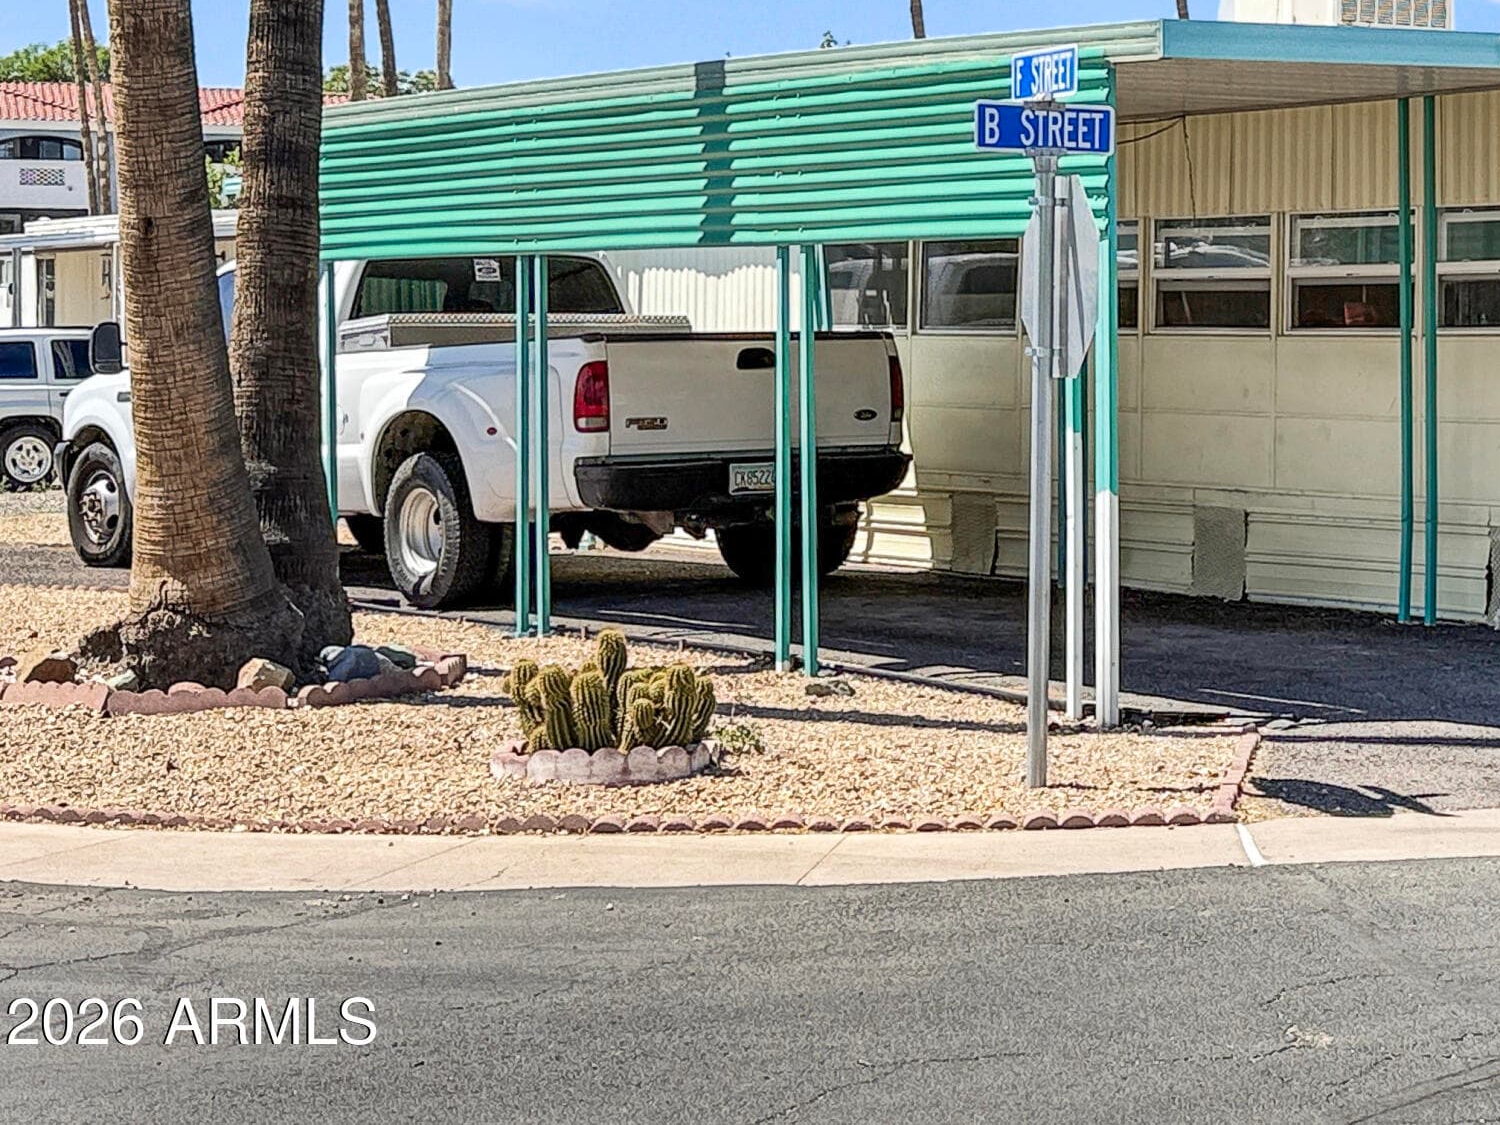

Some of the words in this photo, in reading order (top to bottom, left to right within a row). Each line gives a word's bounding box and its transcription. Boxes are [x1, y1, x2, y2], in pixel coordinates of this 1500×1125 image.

[1016, 59, 1024, 97] F
[1031, 53, 1072, 94] STREET
[984, 107, 1000, 145] B
[1020, 110, 1104, 149] STREET
